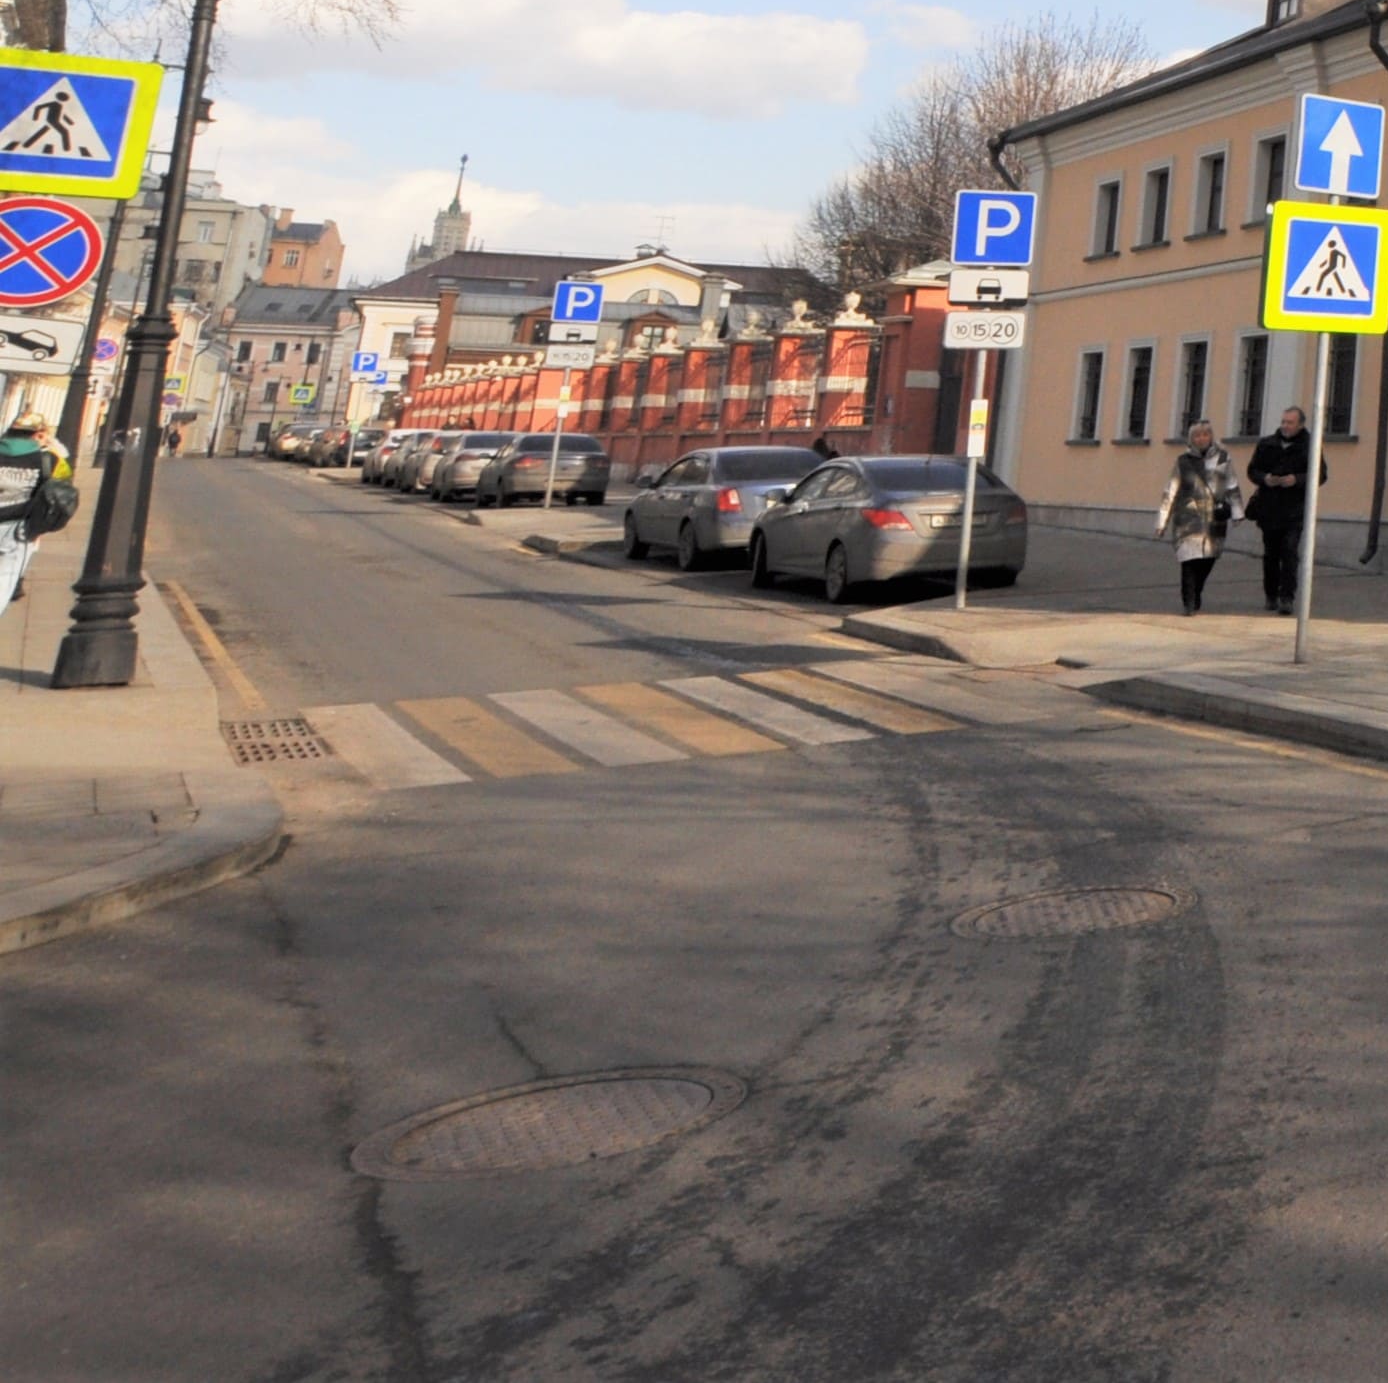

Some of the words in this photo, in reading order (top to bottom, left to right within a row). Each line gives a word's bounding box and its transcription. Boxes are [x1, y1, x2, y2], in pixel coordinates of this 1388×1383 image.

[975, 199, 1021, 256] P
[565, 286, 595, 318] P
[956, 324, 967, 335] 10
[973, 324, 986, 336] 15
[992, 323, 1015, 338] 20
[358, 354, 375, 370] P
